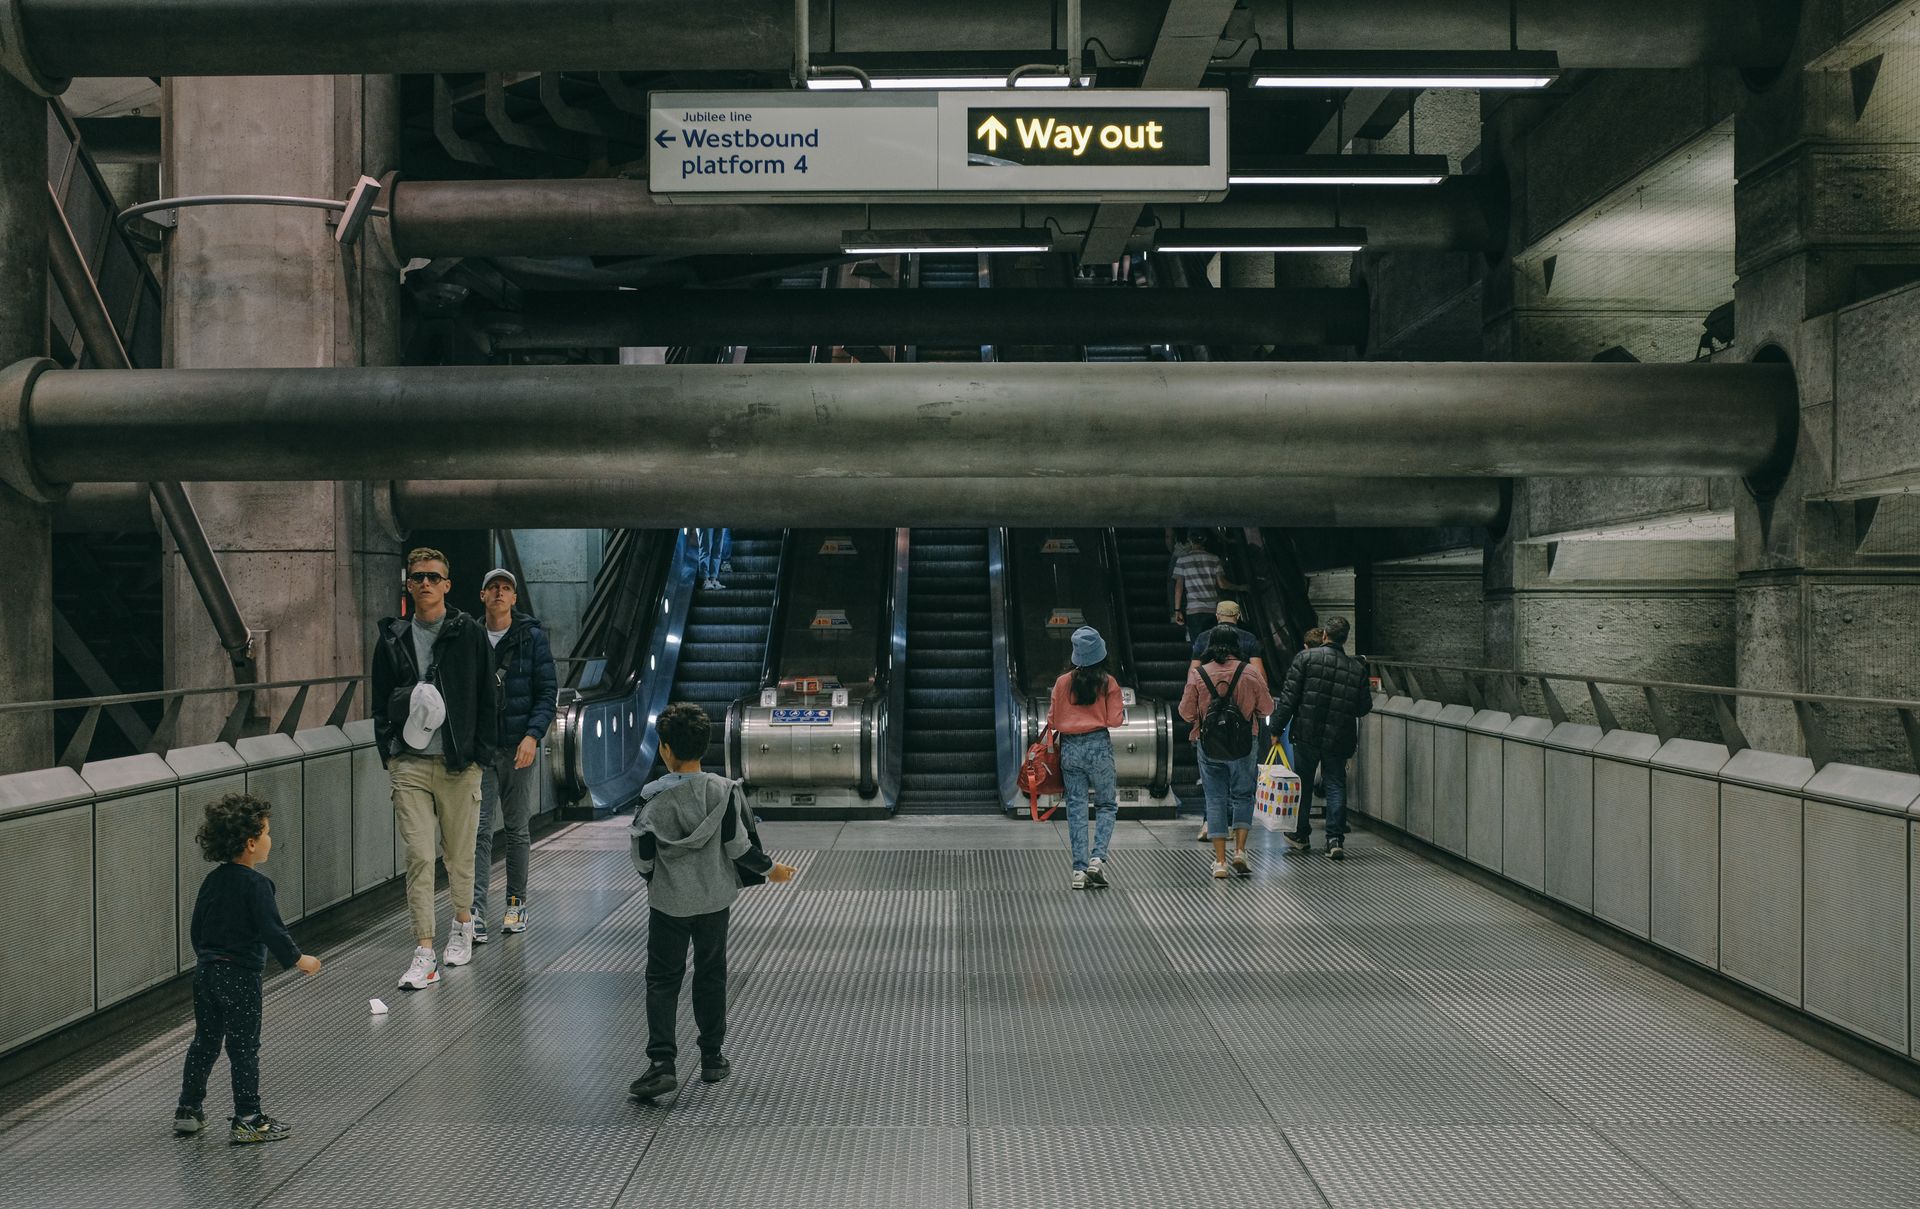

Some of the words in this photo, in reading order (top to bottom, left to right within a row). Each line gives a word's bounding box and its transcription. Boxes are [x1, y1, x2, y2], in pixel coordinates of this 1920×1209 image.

[682, 111, 726, 123] Jubilee
[730, 111, 753, 123] line
[681, 128, 819, 149] Westbound
[1015, 117, 1094, 156] Way
[1099, 121, 1163, 149] out
[681, 154, 785, 179] platform
[793, 154, 809, 174] 4
